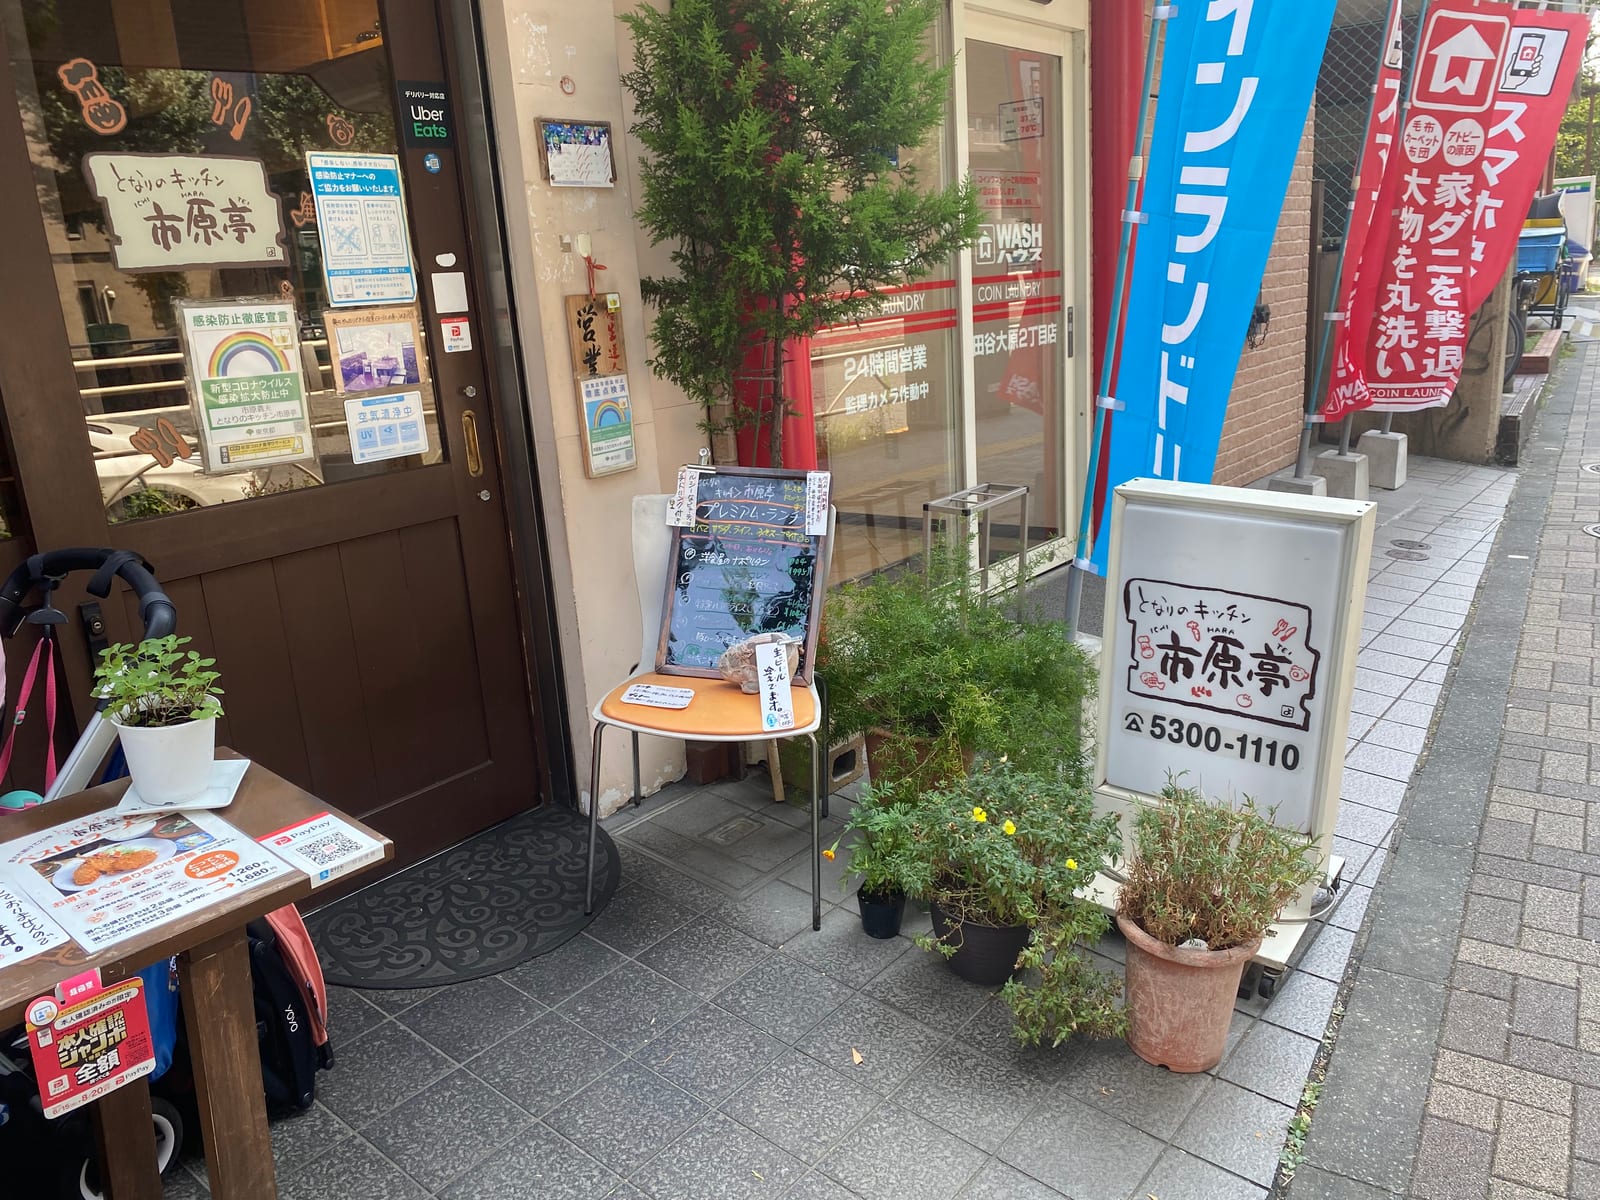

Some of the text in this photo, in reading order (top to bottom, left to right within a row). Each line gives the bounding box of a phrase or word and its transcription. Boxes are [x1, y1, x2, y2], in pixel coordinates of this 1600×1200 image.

[411, 105, 444, 121] Uber
[413, 122, 447, 138] Eats
[1412, 120, 1435, 134] 毛布
[1448, 130, 1481, 143] アトピー
[1405, 132, 1440, 147] カーペット
[1409, 146, 1430, 159] 布団
[1447, 145, 1476, 157] の原因
[110, 162, 224, 193] となりのキッチン
[315, 171, 376, 181] 感染防止マナーへの
[181, 190, 204, 198] HARA
[318, 183, 398, 193] ご協力をお願いいたします。
[143, 198, 256, 252] 市原亭
[995, 223, 1043, 248] WASH
[997, 247, 1043, 264] ハウス
[1376, 168, 1432, 378] 大物を丸洗い
[1420, 172, 1474, 380] 家ダニを撃退
[978, 281, 1042, 302] COIN LAUNDRY
[192, 310, 289, 327] 感染防止徹底宣言
[844, 344, 928, 381] 24時間営業
[210, 377, 293, 393] 新型コロナウイルス
[218, 389, 289, 404] 感染拡大防止中
[216, 408, 297, 425] となりのキッチン市原亭
[743, 483, 776, 503] 市原亭
[698, 502, 803, 526] プレミアム・ランチ
[1138, 586, 1252, 624] となりのキッチン
[1207, 627, 1235, 636] HARA
[1276, 644, 1293, 656] TEI
[773, 647, 786, 682] 生ビール
[1156, 630, 1294, 697] 市原亭
[1150, 714, 1301, 771] 5300-1110
[291, 820, 331, 839] PayPay
[60, 990, 132, 1026] 本人確認済みの方限定
[284, 1003, 299, 1033] YOYO
[57, 1009, 126, 1053] 本人確認
[57, 1024, 128, 1069] ジャンボ
[75, 1048, 121, 1085] 全額
[125, 1065, 150, 1080] PayPay
